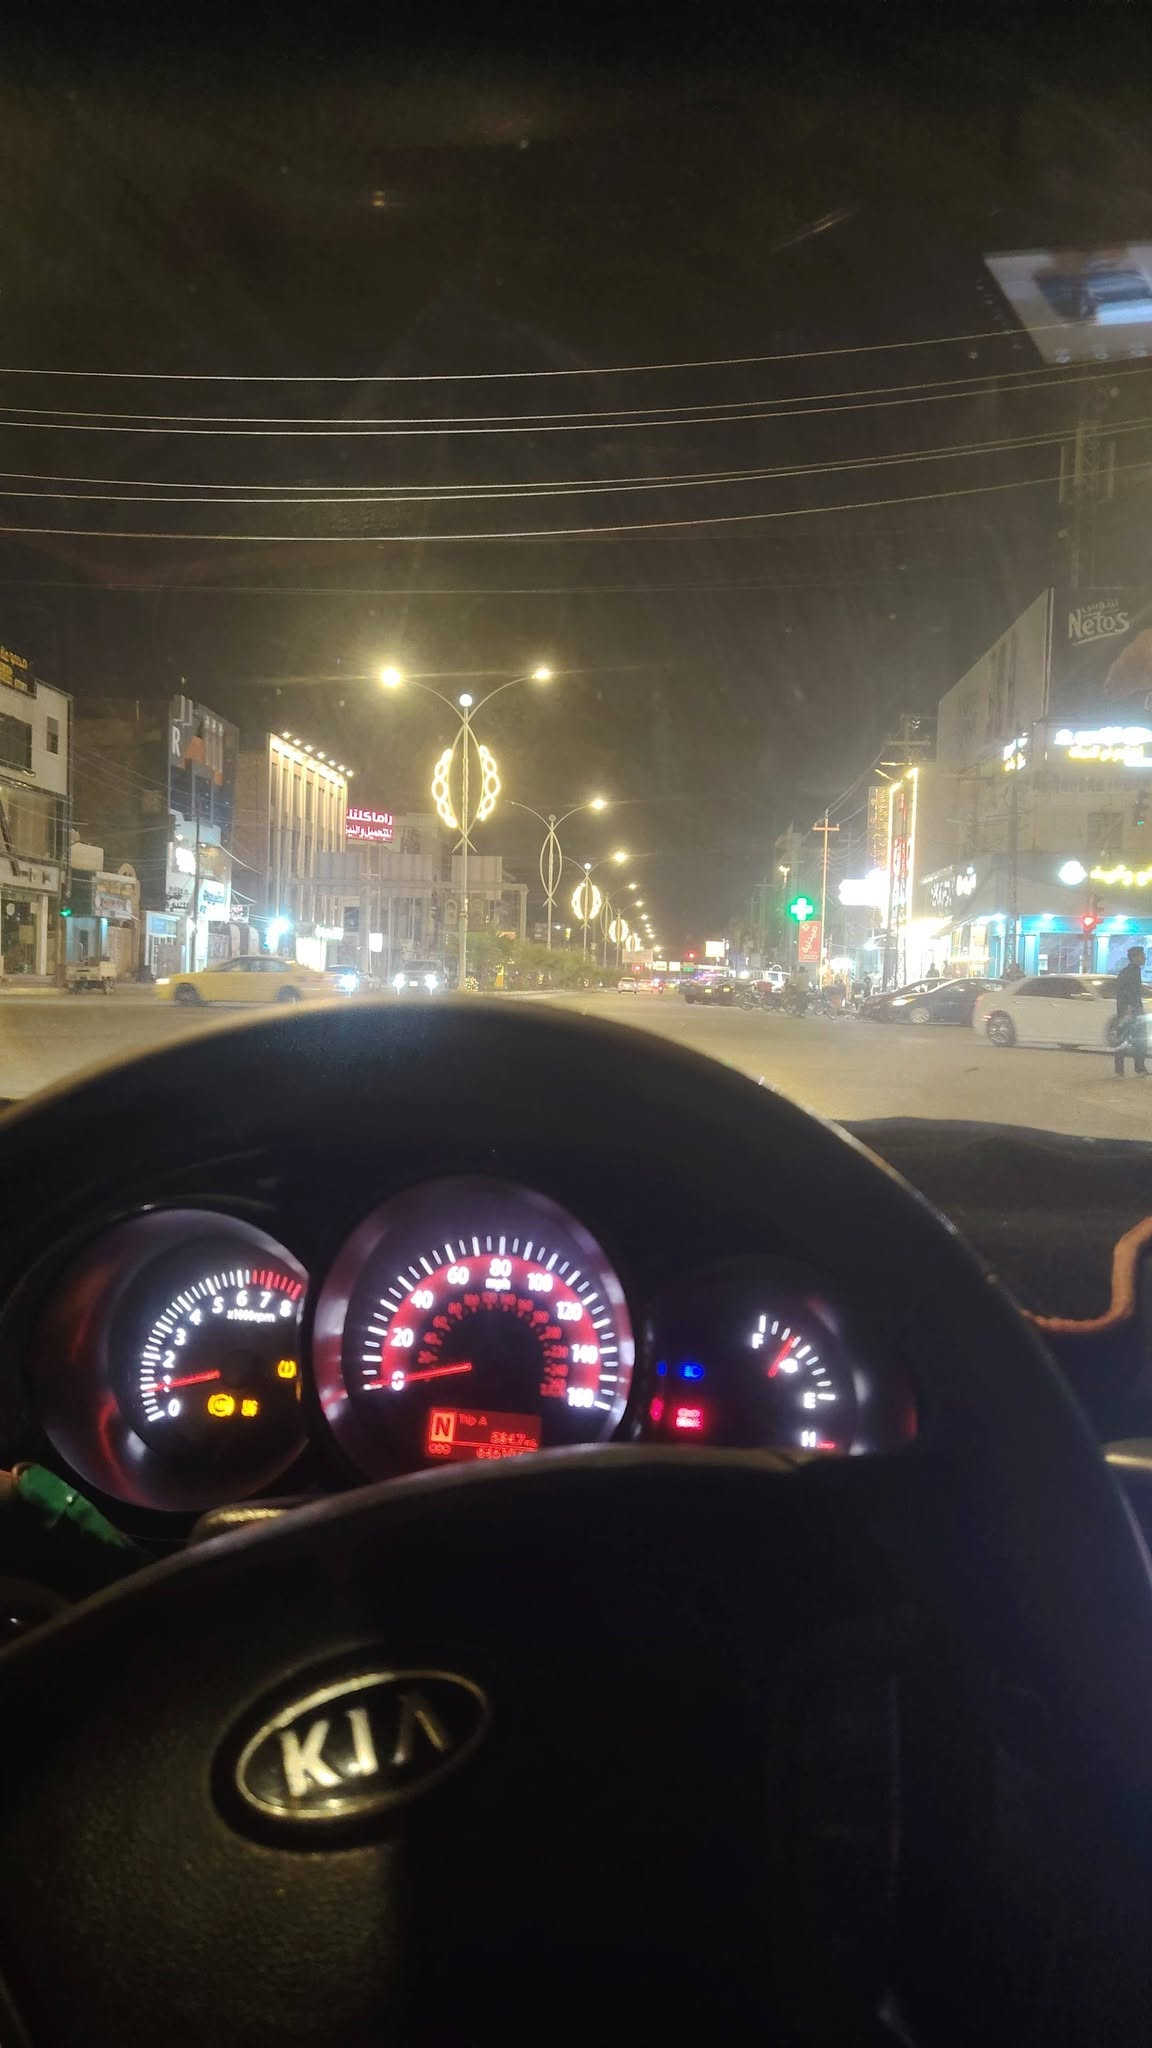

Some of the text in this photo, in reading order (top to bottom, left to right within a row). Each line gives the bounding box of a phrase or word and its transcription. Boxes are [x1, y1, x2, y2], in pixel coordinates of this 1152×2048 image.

[447, 1266, 469, 1285] 60
[489, 1258, 512, 1277] 80
[485, 1277, 511, 1291] mph
[527, 1273, 553, 1292] 100
[212, 1296, 224, 1314] 5
[236, 1290, 248, 1307] 6
[260, 1291, 272, 1308] 7
[279, 1299, 292, 1317] 8
[410, 1290, 434, 1309] 40
[189, 1308, 202, 1326] 4
[556, 1301, 583, 1321] 120
[174, 1328, 186, 1346] 3
[390, 1327, 414, 1348] 20
[752, 1332, 764, 1349] F
[162, 1350, 176, 1369] 2
[571, 1344, 598, 1364] 140
[391, 1370, 405, 1391] 0
[168, 1398, 181, 1417] 0
[803, 1392, 816, 1409] E
[435, 1416, 449, 1437] N
[801, 1430, 816, 1448] H
